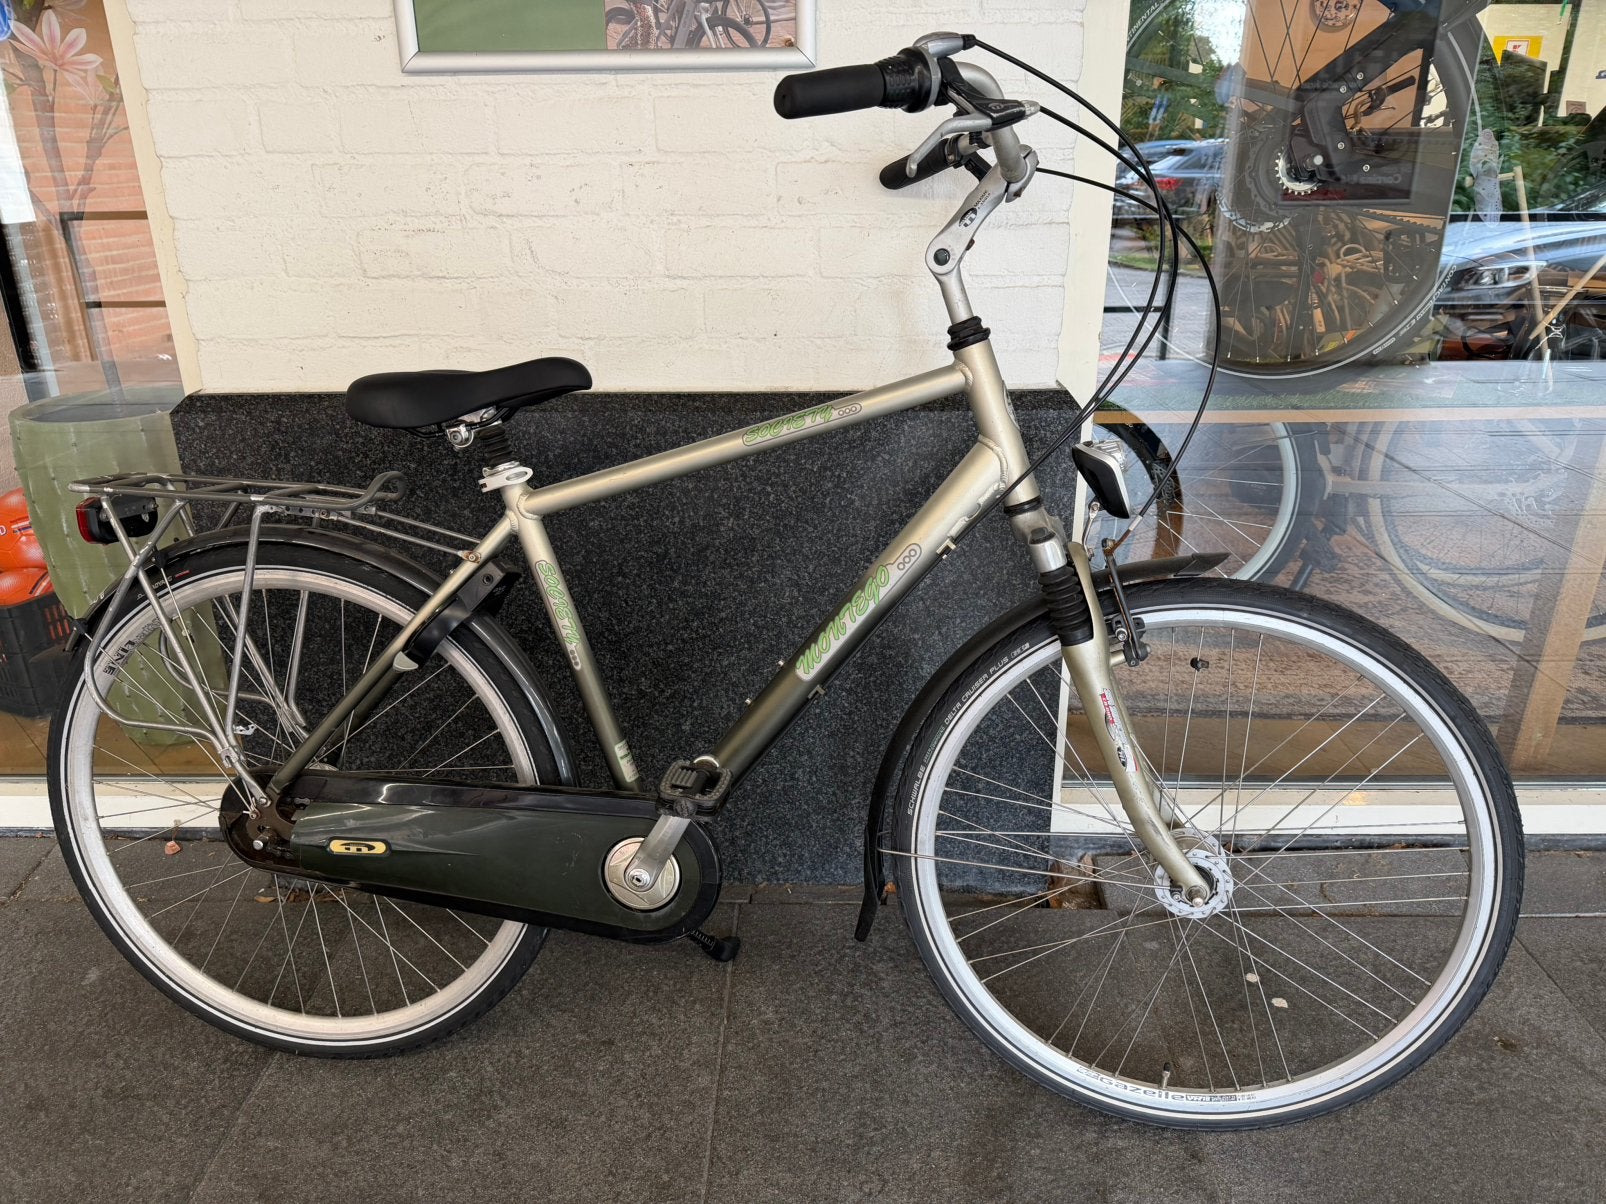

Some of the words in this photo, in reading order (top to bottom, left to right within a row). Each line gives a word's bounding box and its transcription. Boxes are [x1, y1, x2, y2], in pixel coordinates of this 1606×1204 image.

[744, 404, 833, 443] SOCIETY
[538, 561, 582, 645] SOCIETY
[907, 764, 926, 816] SCHWALBE
[943, 702, 963, 726] DELTA
[961, 673, 989, 702] CRUISER
[989, 656, 1010, 675] PLUS
